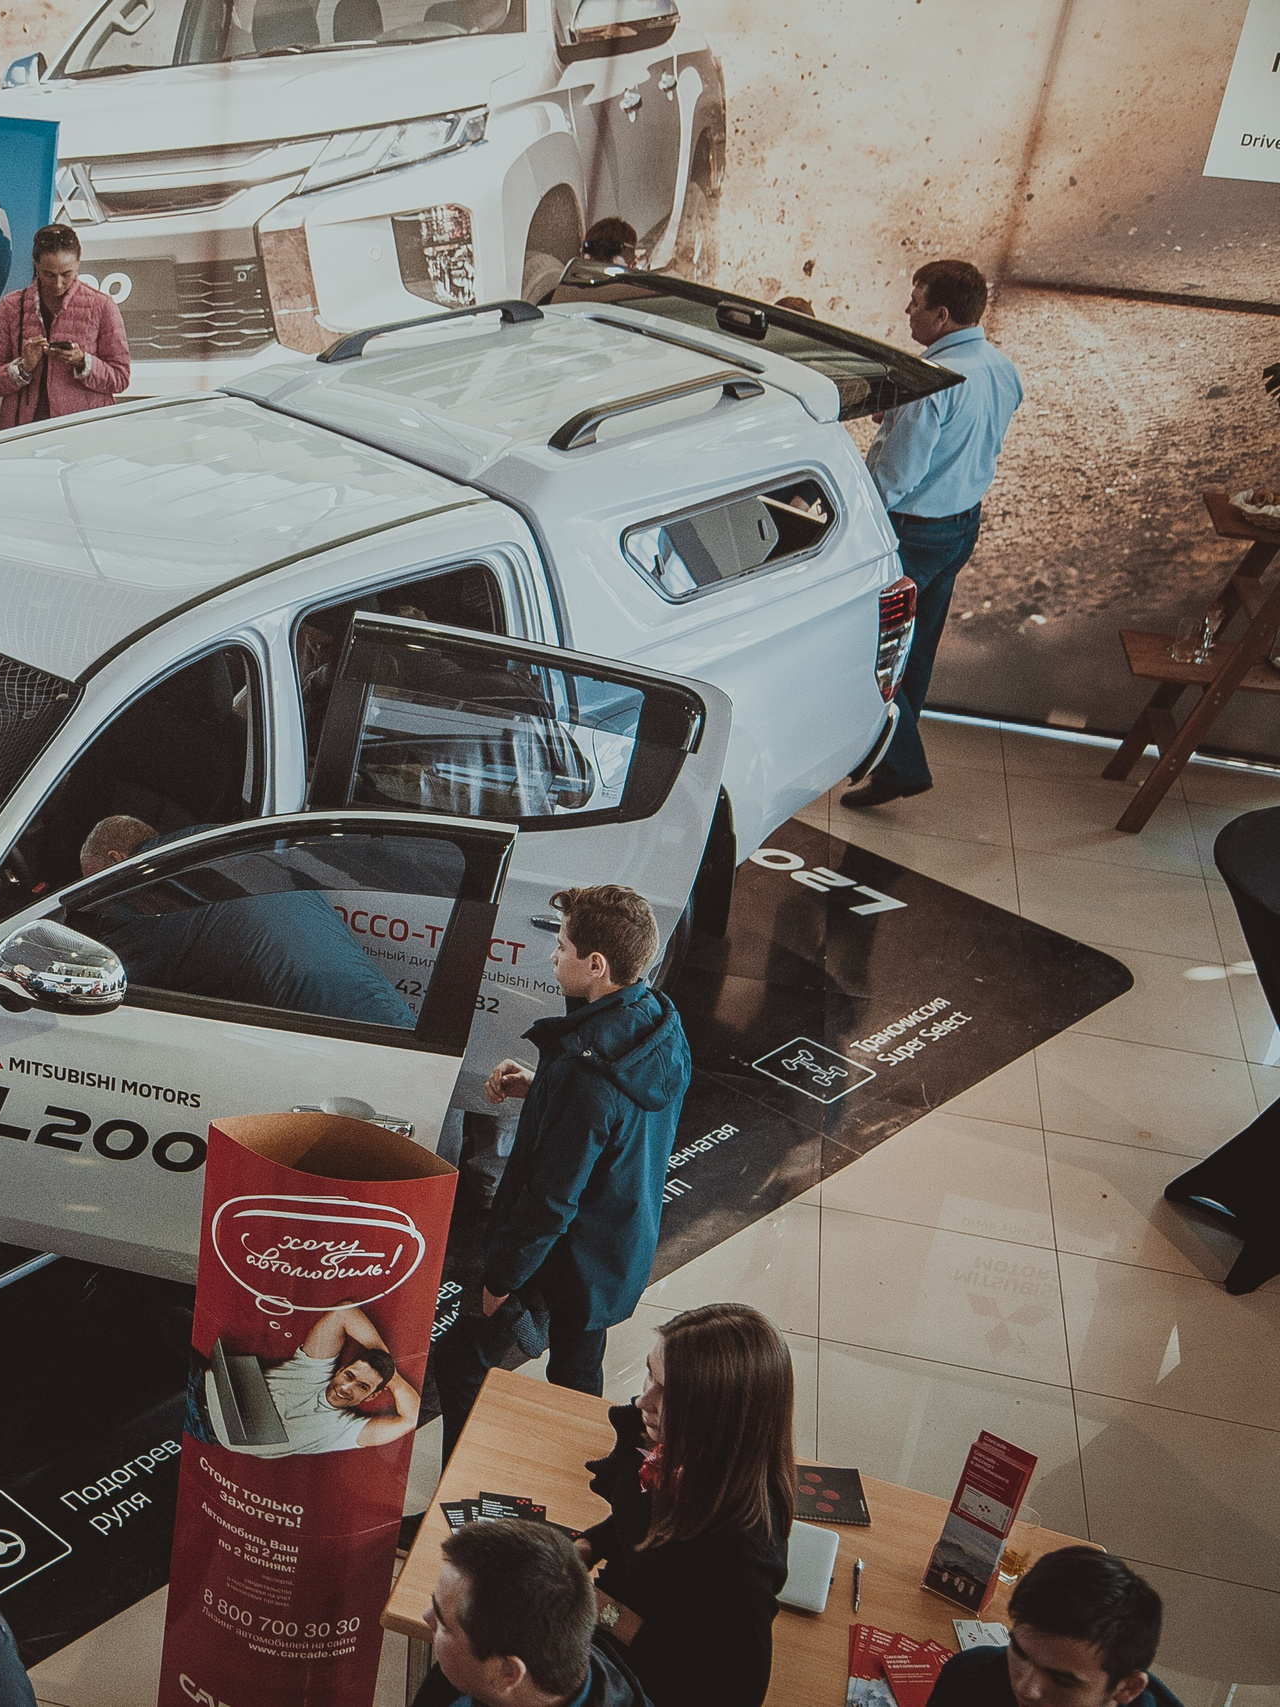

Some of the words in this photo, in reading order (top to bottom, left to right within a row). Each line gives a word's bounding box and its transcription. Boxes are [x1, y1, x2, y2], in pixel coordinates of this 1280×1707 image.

[749, 848, 909, 916] L20
[849, 997, 951, 1052] Трансмиссия
[876, 1036, 927, 1067] Super
[919, 1011, 973, 1042] Select
[8, 1056, 116, 1092] MITSUBISHI
[121, 1079, 202, 1108] MOTORS
[666, 1123, 740, 1173] енчатая
[60, 1440, 182, 1511] Подогрев
[199, 1456, 240, 1494] Стоит
[241, 1487, 304, 1515] только
[89, 1492, 152, 1535] руля
[201, 1501, 267, 1546] Автомобиль
[270, 1539, 299, 1553] Ваш
[219, 1489, 302, 1529] захотеть!
[218, 1538, 232, 1552] по
[233, 1546, 241, 1557] 2
[244, 1552, 296, 1573] копиям:
[244, 1542, 259, 1554] за
[262, 1548, 270, 1558] 2
[272, 1553, 298, 1564] дня
[201, 1605, 234, 1631] Лизинг
[235, 1627, 309, 1649] автомобилей
[311, 1640, 325, 1649] на
[326, 1635, 357, 1648] сайте
[203, 1588, 213, 1605] 8
[217, 1598, 253, 1626] 800
[258, 1615, 298, 1637] 700
[304, 1622, 330, 1638] 30
[335, 1616, 360, 1635] 30
[248, 1642, 356, 1659] www.carcade.com
